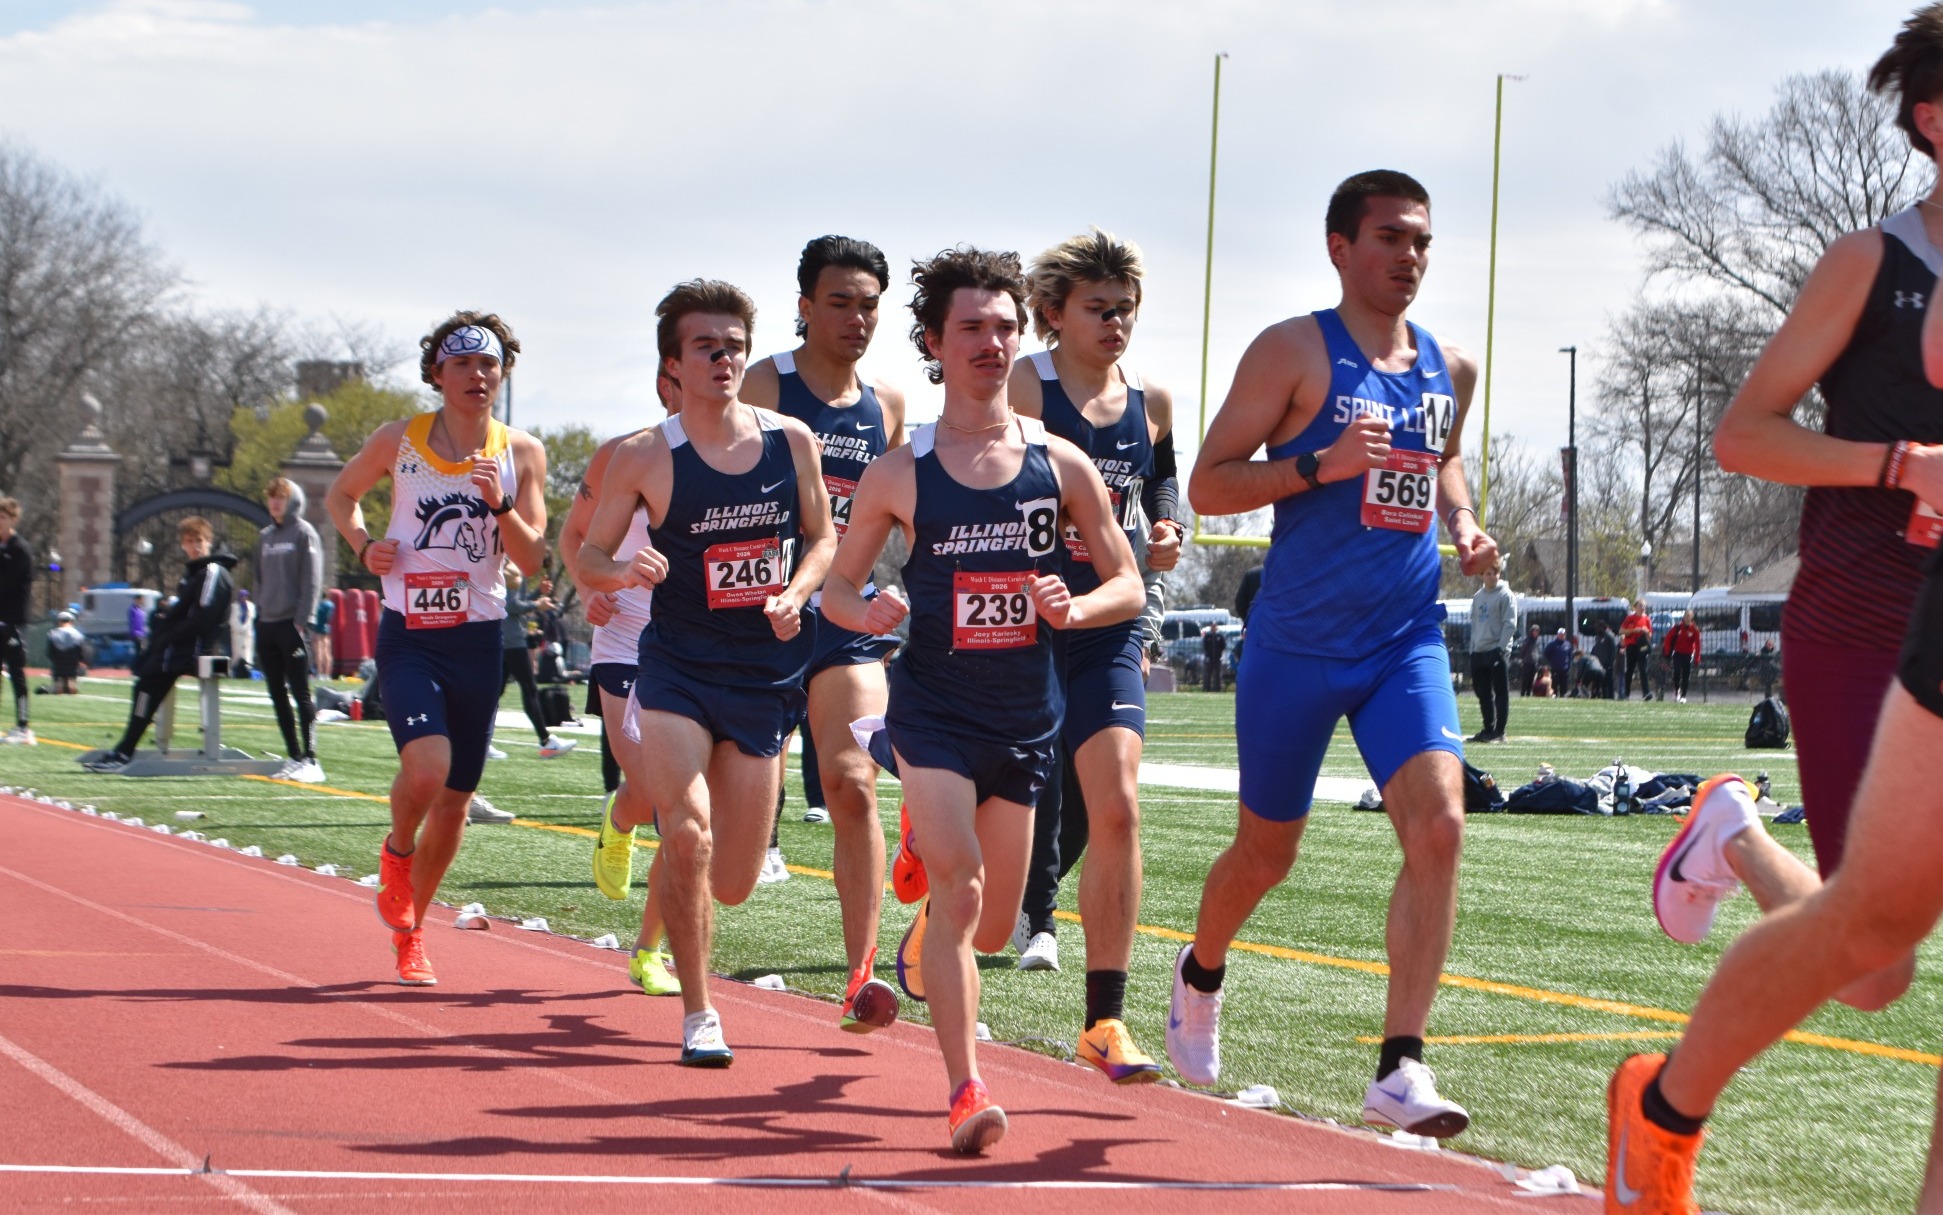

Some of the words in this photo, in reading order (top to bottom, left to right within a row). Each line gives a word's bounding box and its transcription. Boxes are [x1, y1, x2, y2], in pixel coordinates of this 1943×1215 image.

[1426, 398, 1450, 446] 14
[814, 432, 869, 450] LINOIS
[1376, 471, 1431, 508] 569
[704, 501, 779, 520] ILLINOIS
[830, 495, 853, 524] 44
[690, 511, 790, 534] SPRINGFIELD
[949, 522, 1027, 541] ILLINOI
[1028, 507, 1055, 553] 8
[932, 536, 1029, 556] SPRINGFI
[716, 558, 772, 589] 246
[414, 587, 462, 611] 446
[720, 595, 769, 603] Illinois-Springfie
[966, 594, 1028, 626] 239
